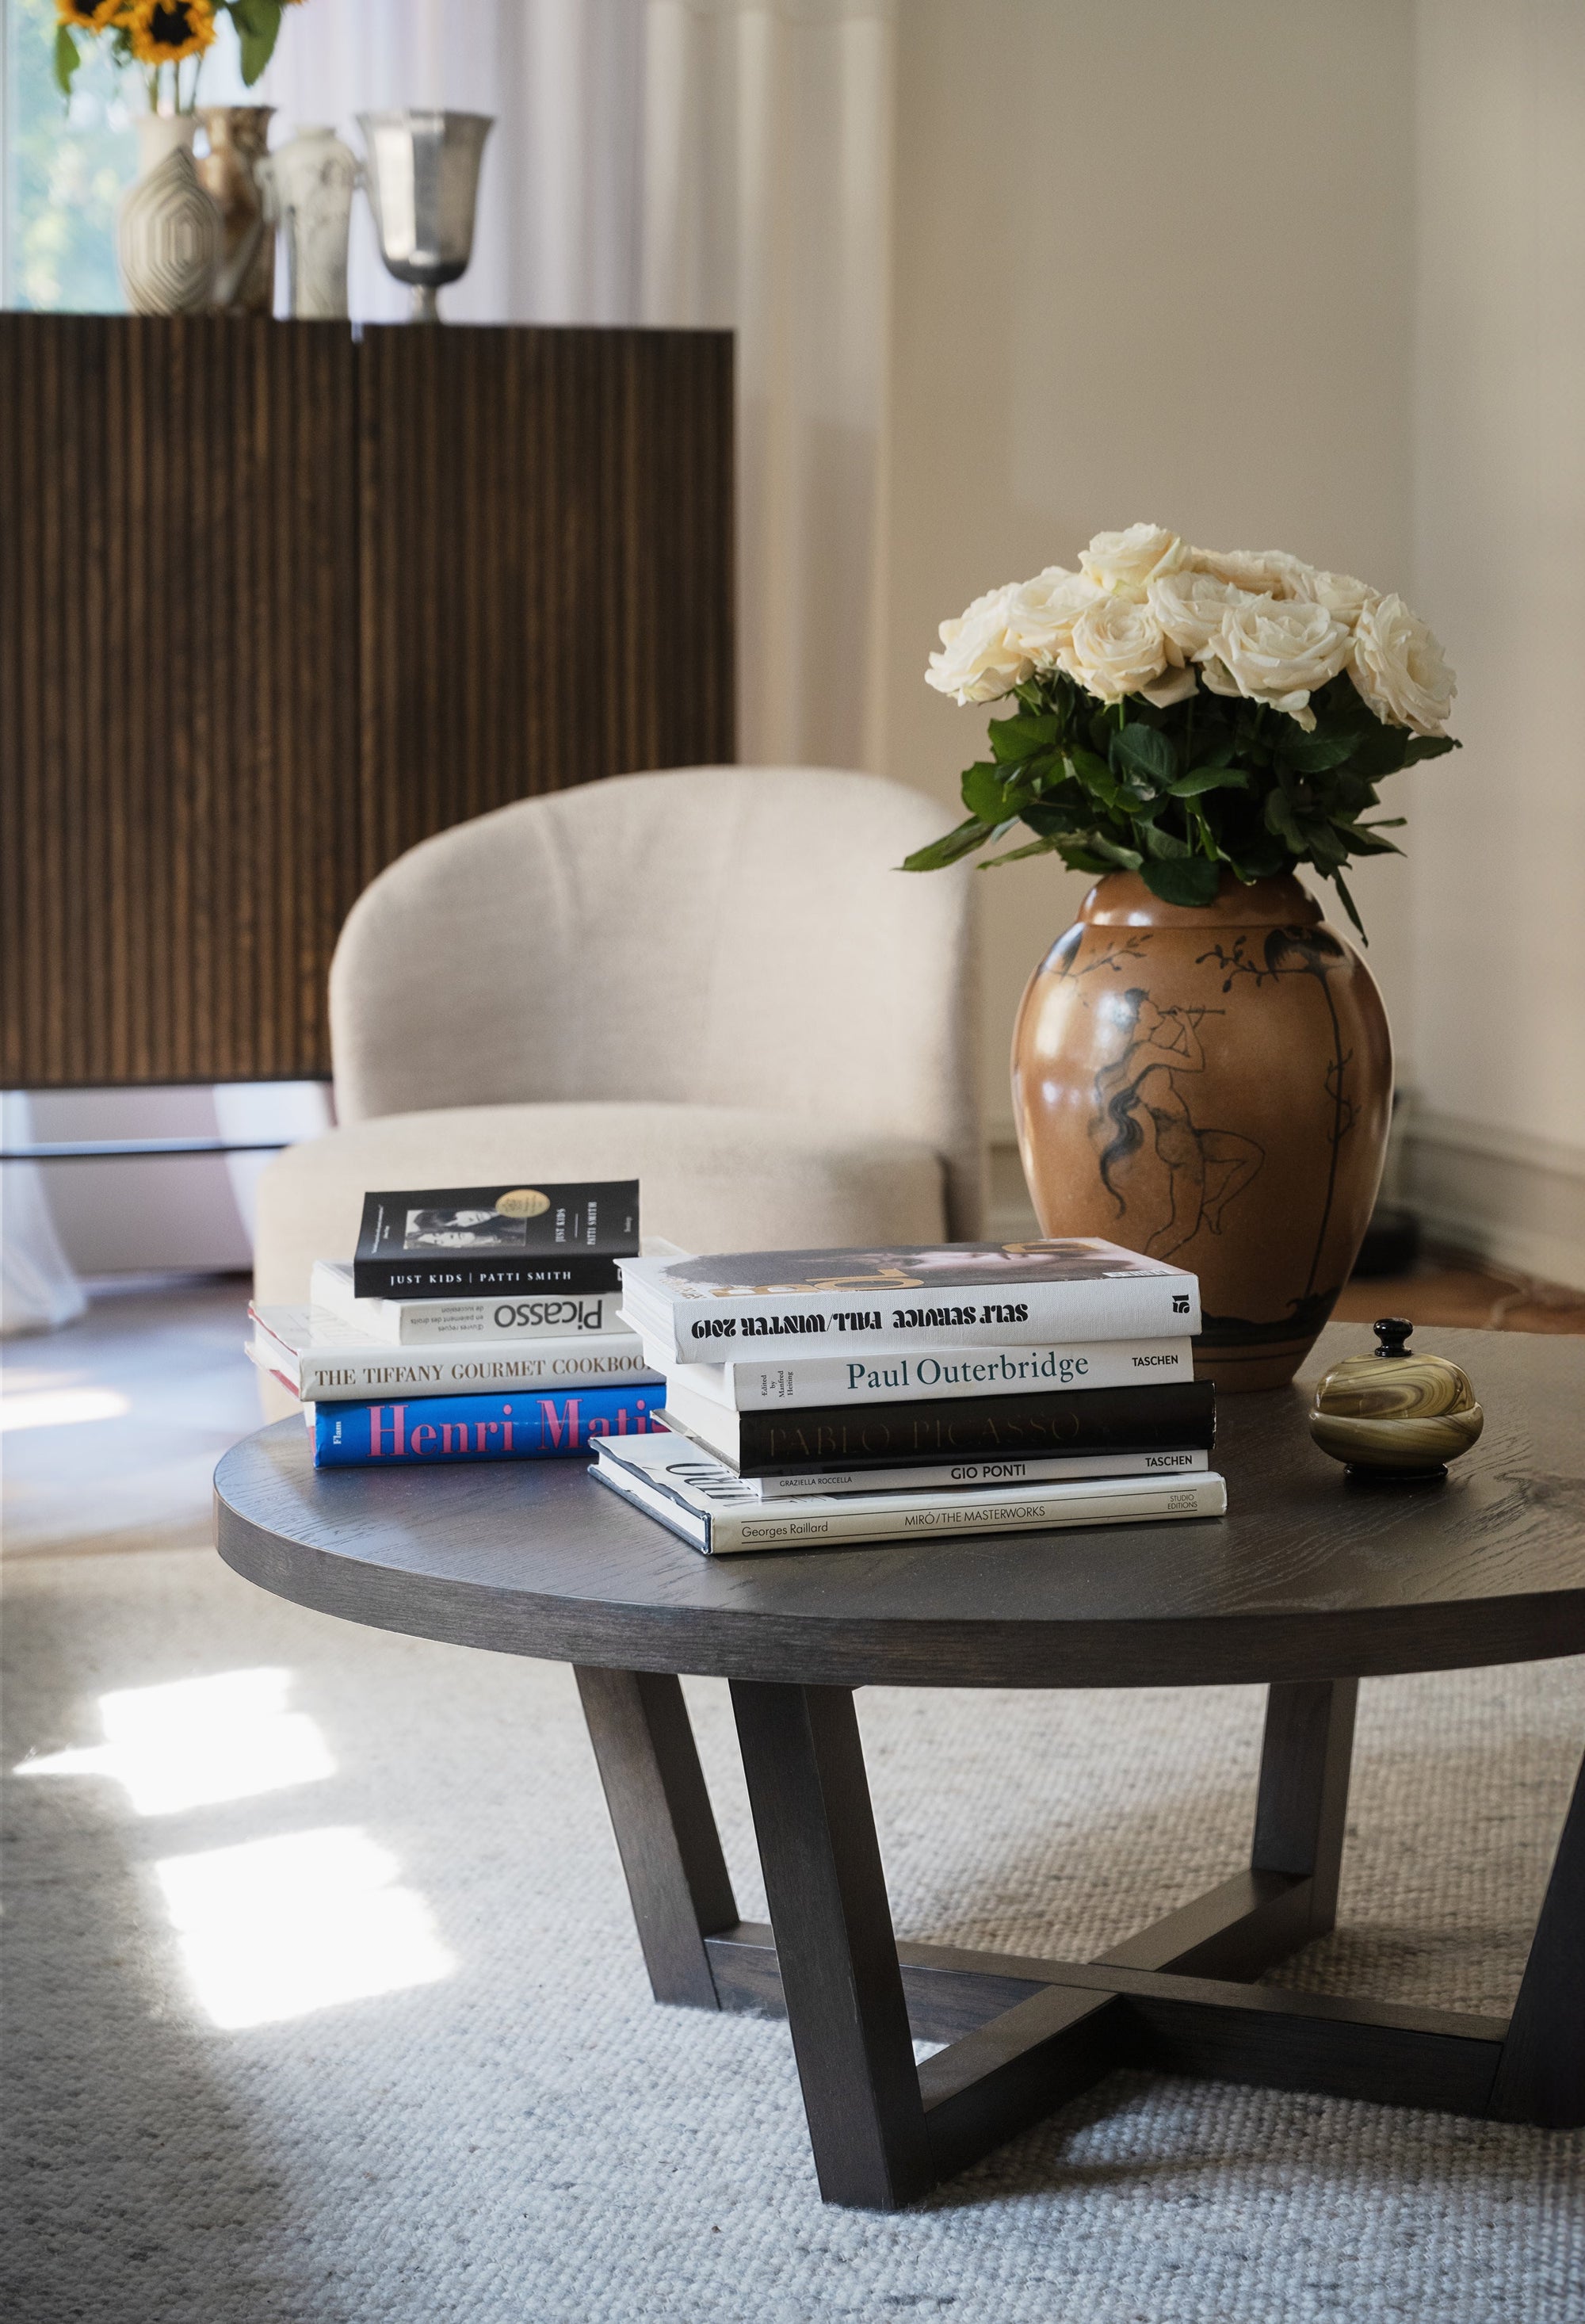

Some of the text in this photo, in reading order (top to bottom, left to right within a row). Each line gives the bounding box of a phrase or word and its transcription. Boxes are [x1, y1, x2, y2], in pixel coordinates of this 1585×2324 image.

[391, 1271, 572, 1286] JUST KIDS PATTI SMITH
[980, 1303, 1029, 1324] SELF
[1171, 1294, 1190, 1314] 51
[494, 1299, 603, 1330] Picasso
[892, 1305, 977, 1329] SERVICE
[691, 1318, 736, 1340] 2019
[315, 1355, 651, 1386] THE TIFFANY GOURMET COOKBOO
[846, 1351, 1090, 1389] Paul Outerbridge
[1132, 1355, 1179, 1366] TASCHEN
[333, 1421, 342, 1445] Flam
[366, 1397, 672, 1458] Henri Mati
[770, 1411, 1081, 1457] PABLO PICASSO
[1144, 1455, 1193, 1467] TASCHEN
[950, 1464, 1026, 1480] GIO PONTI
[779, 1477, 853, 1488] GRAZIELLA ROCCELLA
[964, 1506, 1046, 1522] MASTERWORKS
[1167, 1500, 1198, 1510] EDITIONS
[741, 1521, 829, 1539] Georges Raillard
